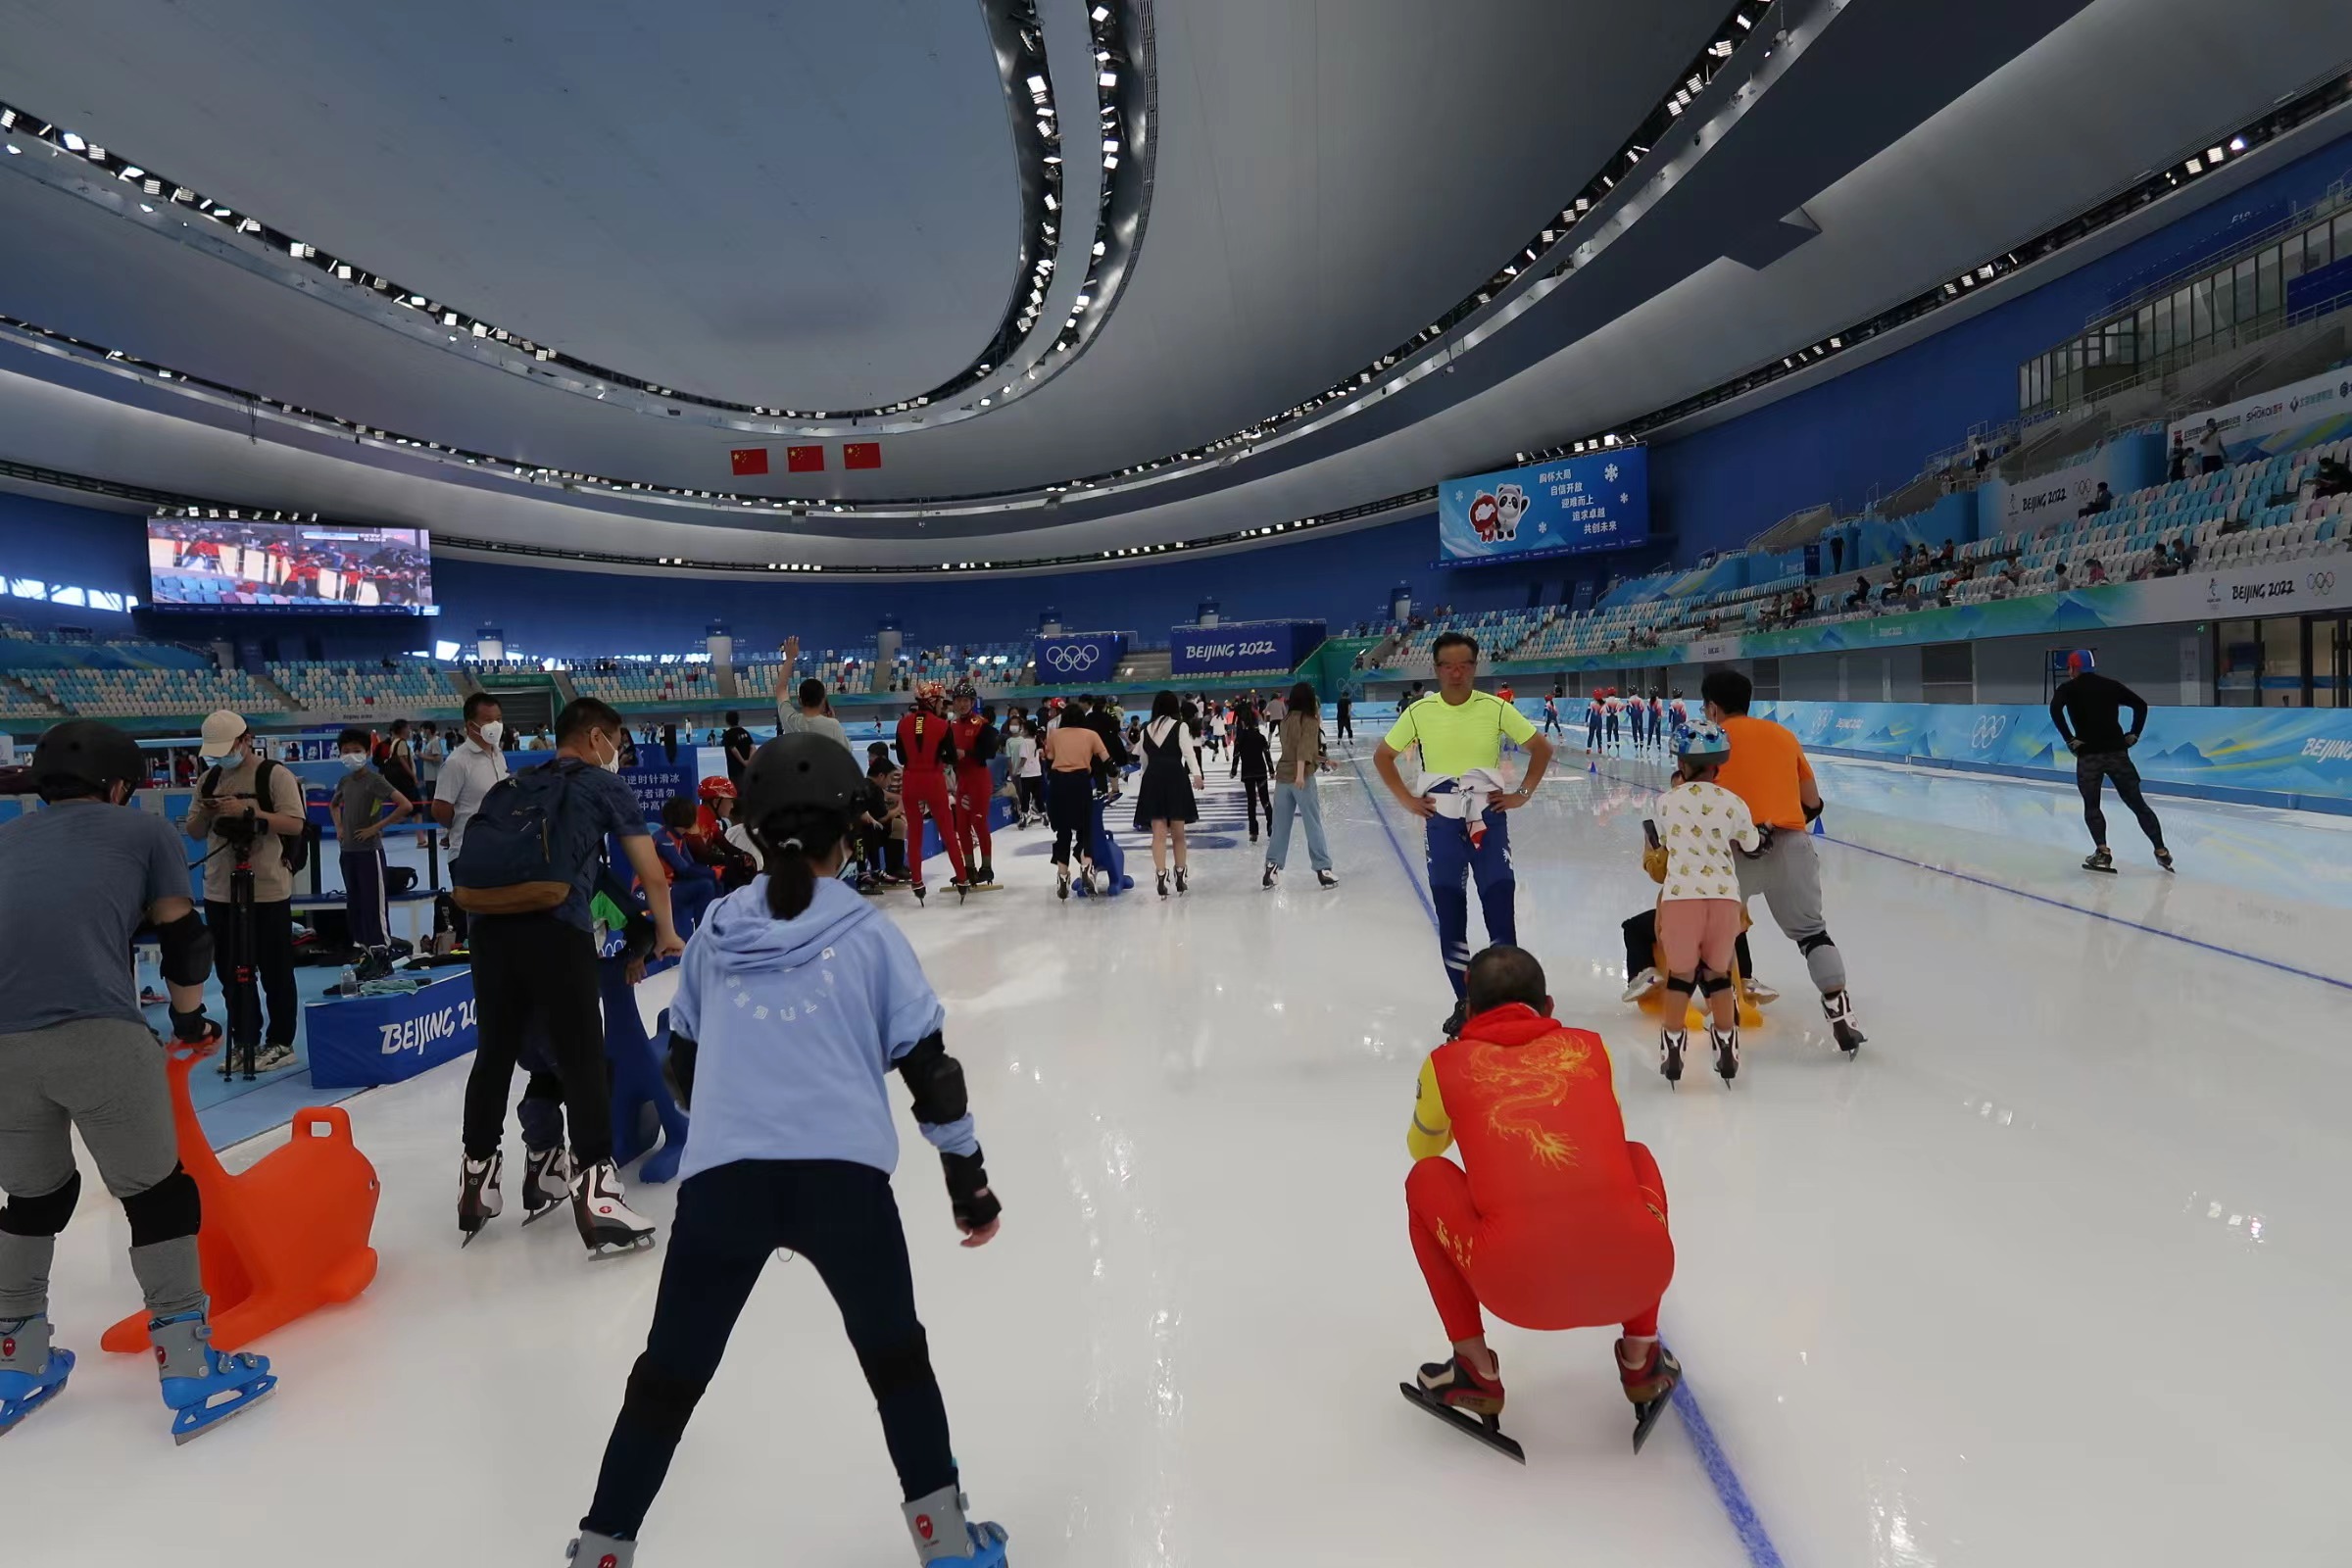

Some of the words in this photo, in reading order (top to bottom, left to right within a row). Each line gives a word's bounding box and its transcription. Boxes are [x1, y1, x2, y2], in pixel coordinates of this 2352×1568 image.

[1539, 468, 1572, 484] 胸怀大局
[1550, 481, 1583, 497] 自信开放
[1561, 494, 1594, 509] 迎难而上
[2023, 493, 2046, 514] BEIJING
[2048, 488, 2067, 505] 2022
[1572, 507, 1606, 521] 追求卓越
[1584, 520, 1617, 534] 共创未来
[2232, 583, 2266, 604] BEIJING
[2268, 580, 2295, 597] 2022
[1186, 643, 1235, 662] BEIJING
[1238, 641, 1276, 656] 2022
[915, 716, 924, 734] CHINA
[378, 1006, 456, 1055] BEIJING
